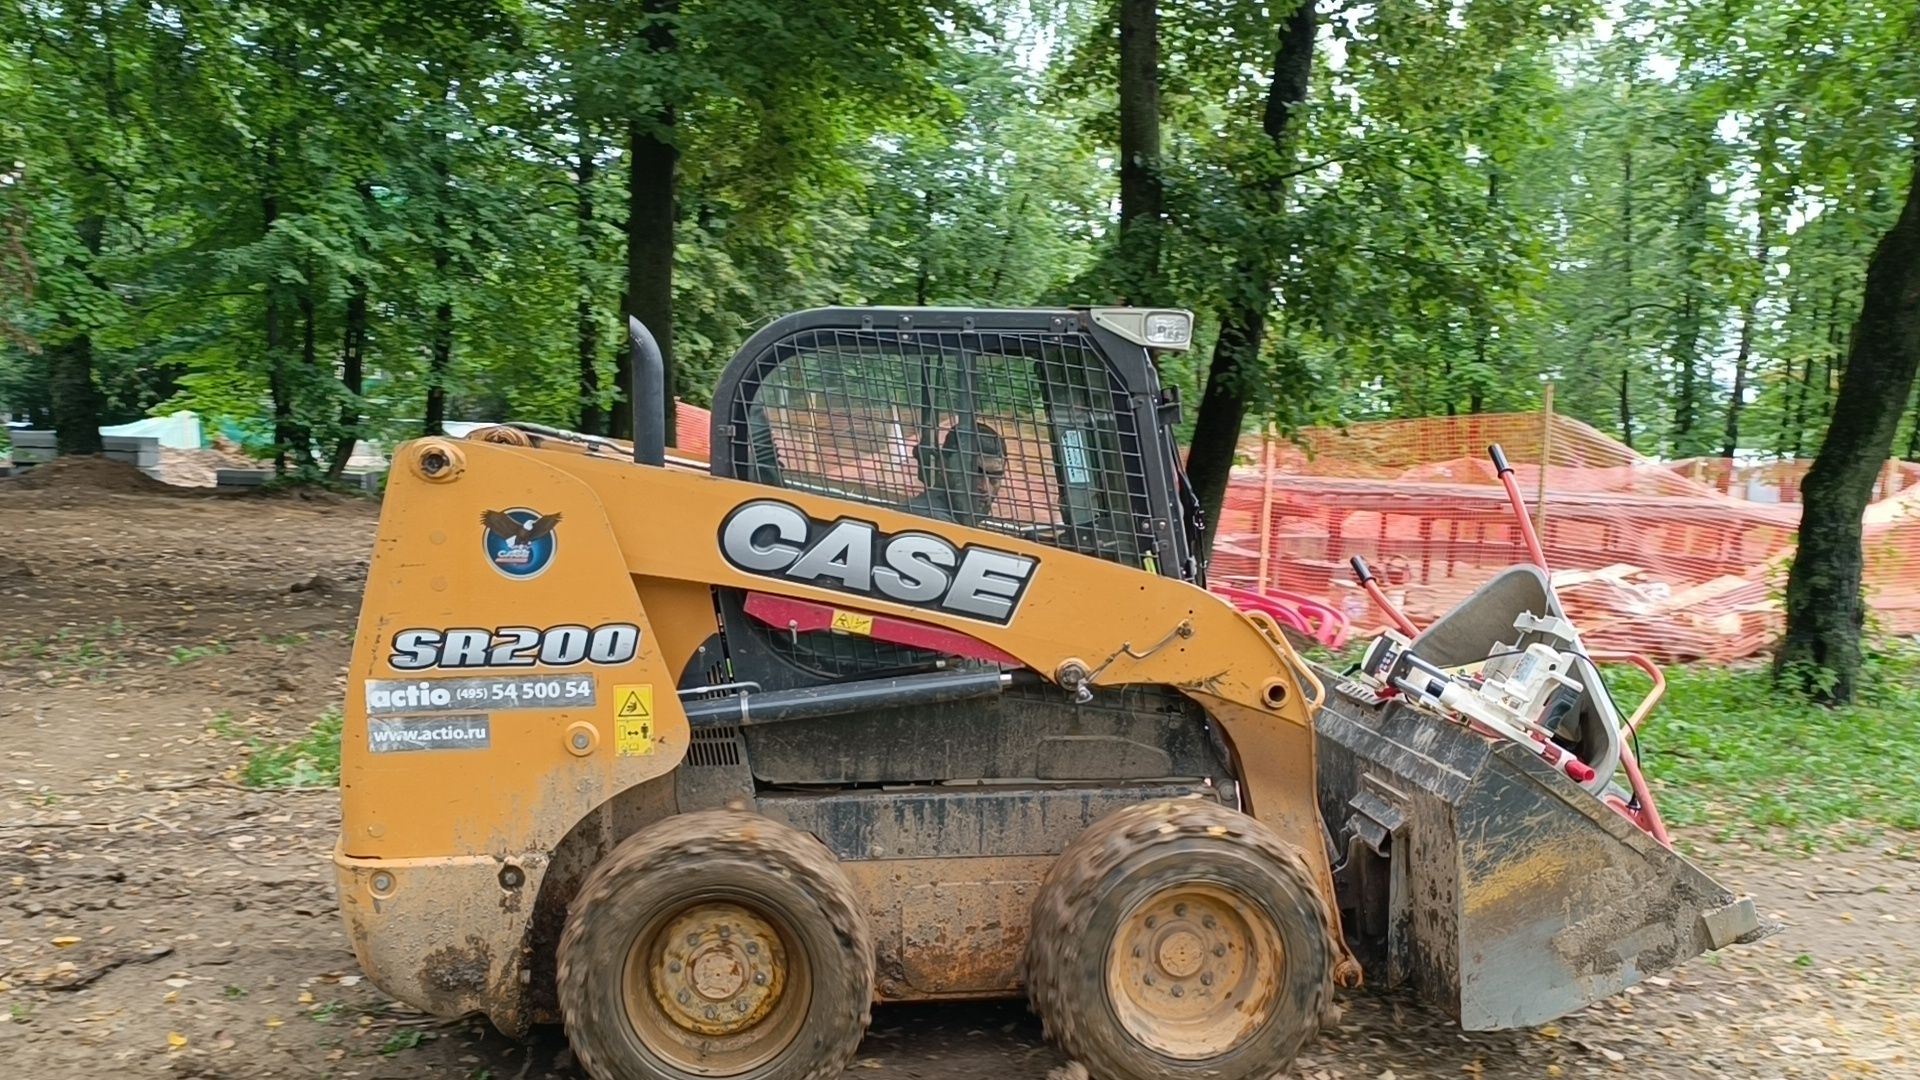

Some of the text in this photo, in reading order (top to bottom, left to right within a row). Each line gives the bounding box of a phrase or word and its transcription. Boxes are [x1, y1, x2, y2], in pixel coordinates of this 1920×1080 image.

[721, 500, 1038, 621] CASE
[390, 622, 640, 670] SR200
[371, 681, 591, 707] actio (495) 54 500 54
[373, 726, 486, 743] www.actio.ru
